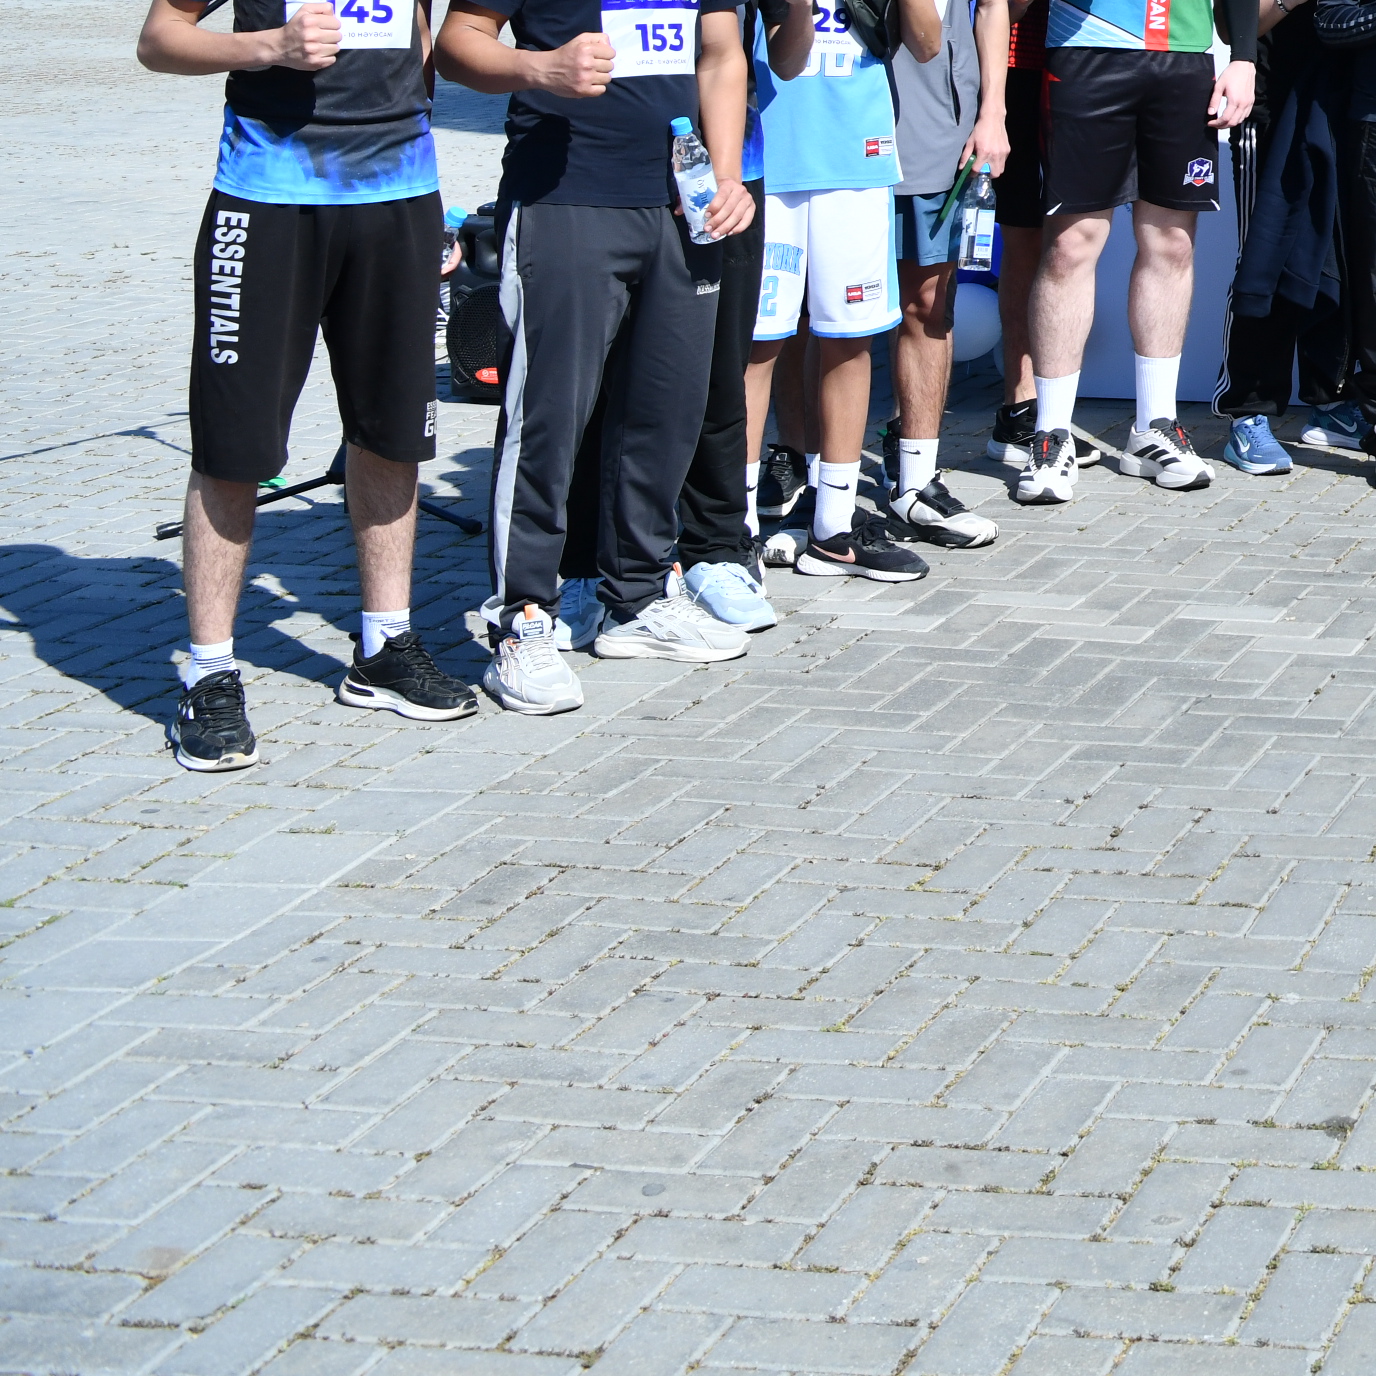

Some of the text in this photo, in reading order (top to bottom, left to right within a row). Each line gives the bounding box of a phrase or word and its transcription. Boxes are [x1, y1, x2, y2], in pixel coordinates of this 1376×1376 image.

[814, 7, 851, 33] 29
[635, 23, 684, 52] 153
[764, 242, 804, 276] YORK
[210, 210, 251, 365] ESSENTIALS
[760, 275, 779, 318] 2
[847, 289, 862, 298] USA
